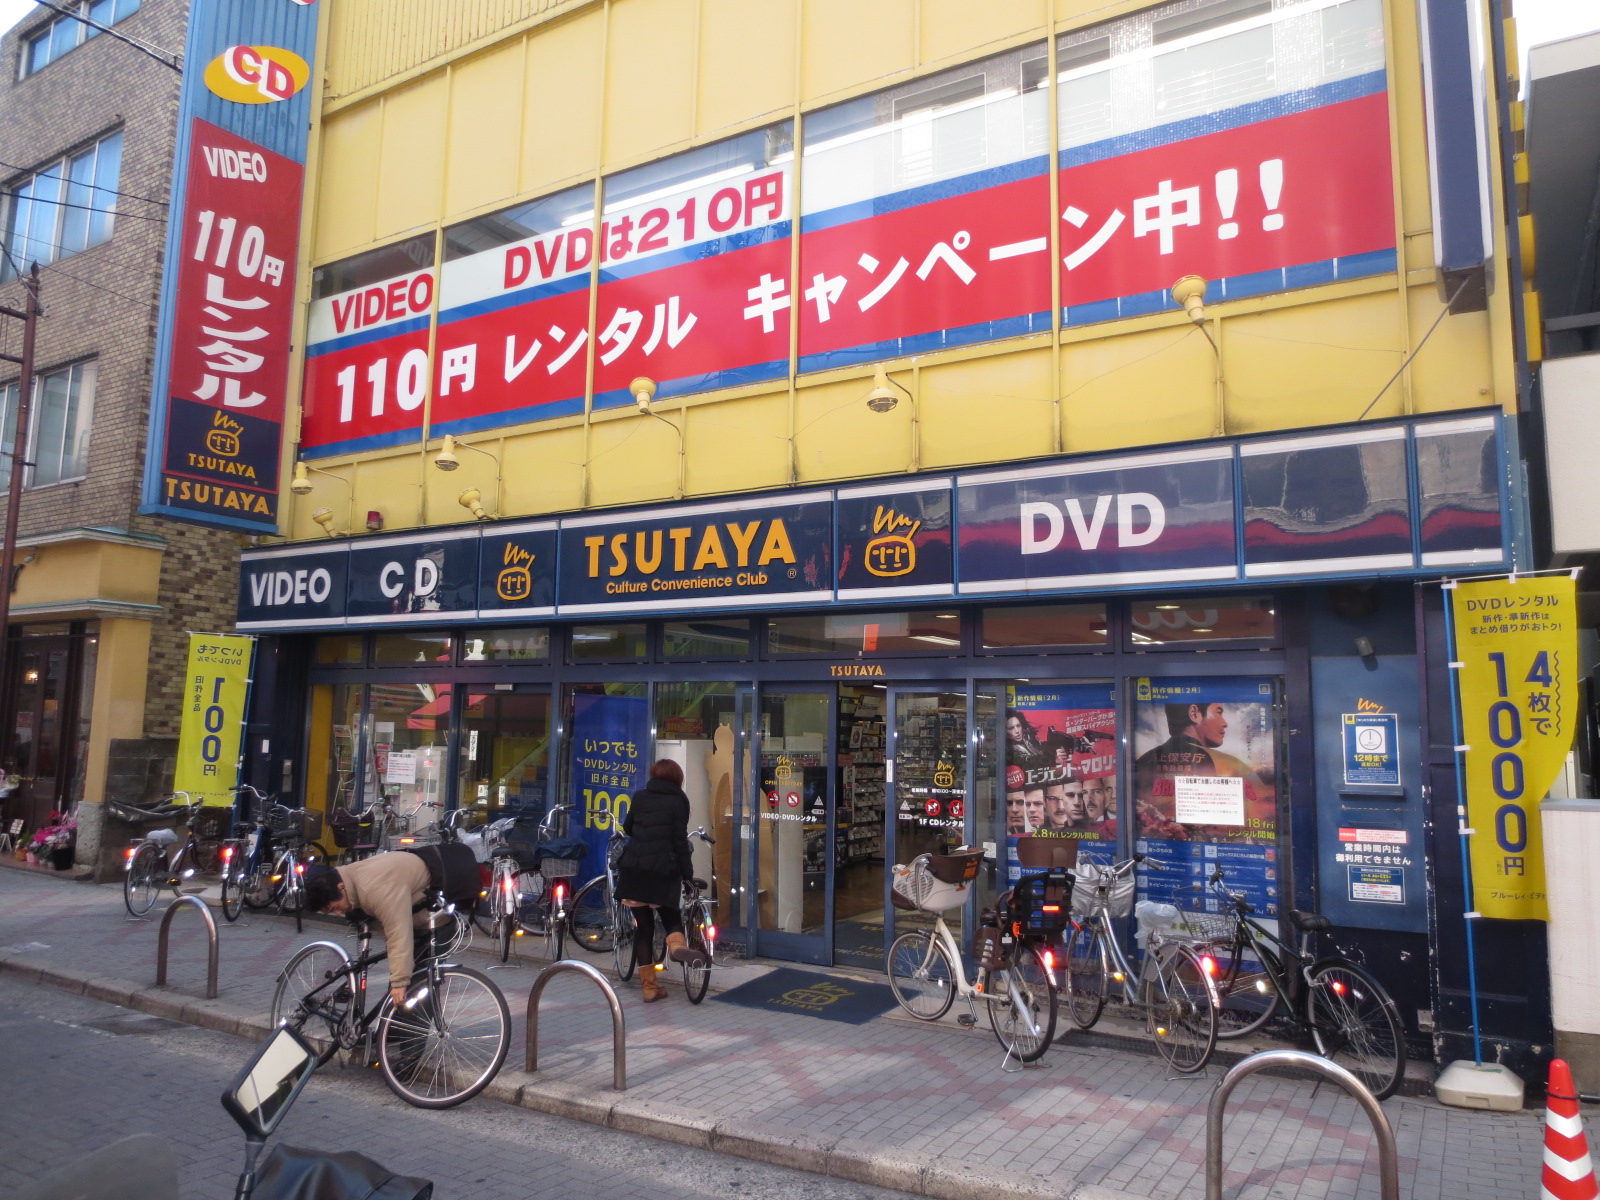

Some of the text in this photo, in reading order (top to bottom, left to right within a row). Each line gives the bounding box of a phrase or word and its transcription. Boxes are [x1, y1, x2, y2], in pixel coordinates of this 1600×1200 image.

[224, 45, 295, 100] CD
[202, 146, 267, 183] VIDEO
[193, 210, 285, 287] 110円
[331, 171, 784, 334] VIDEO DVDは210円
[192, 274, 271, 408] レンタル
[336, 344, 478, 422] 110円
[503, 295, 698, 384] レンタル
[188, 453, 256, 478] TSUTAYA
[166, 478, 270, 515] TSUTAYA
[1019, 492, 1166, 555] DVD
[585, 518, 797, 578] TSUTAYA
[249, 567, 332, 608] VIDEO
[606, 571, 768, 595] Culture Convenience Club
[1467, 595, 1559, 612] DVDレンタル
[1482, 612, 1550, 624] 新作・準新作は
[1470, 623, 1562, 635] まとめ借りがおトク!
[830, 665, 883, 677] TSUTAYA
[1524, 650, 1553, 736] 4枚で
[585, 739, 638, 758] いつでも
[1488, 652, 1527, 876] 1000円
[584, 758, 637, 773] DVDレンタル
[591, 773, 630, 787] 旧作全品
[1061, 831, 1100, 840] レンタル開始
[1229, 830, 1276, 840] レンタル開始
[1345, 842, 1401, 854] 営業時間内は
